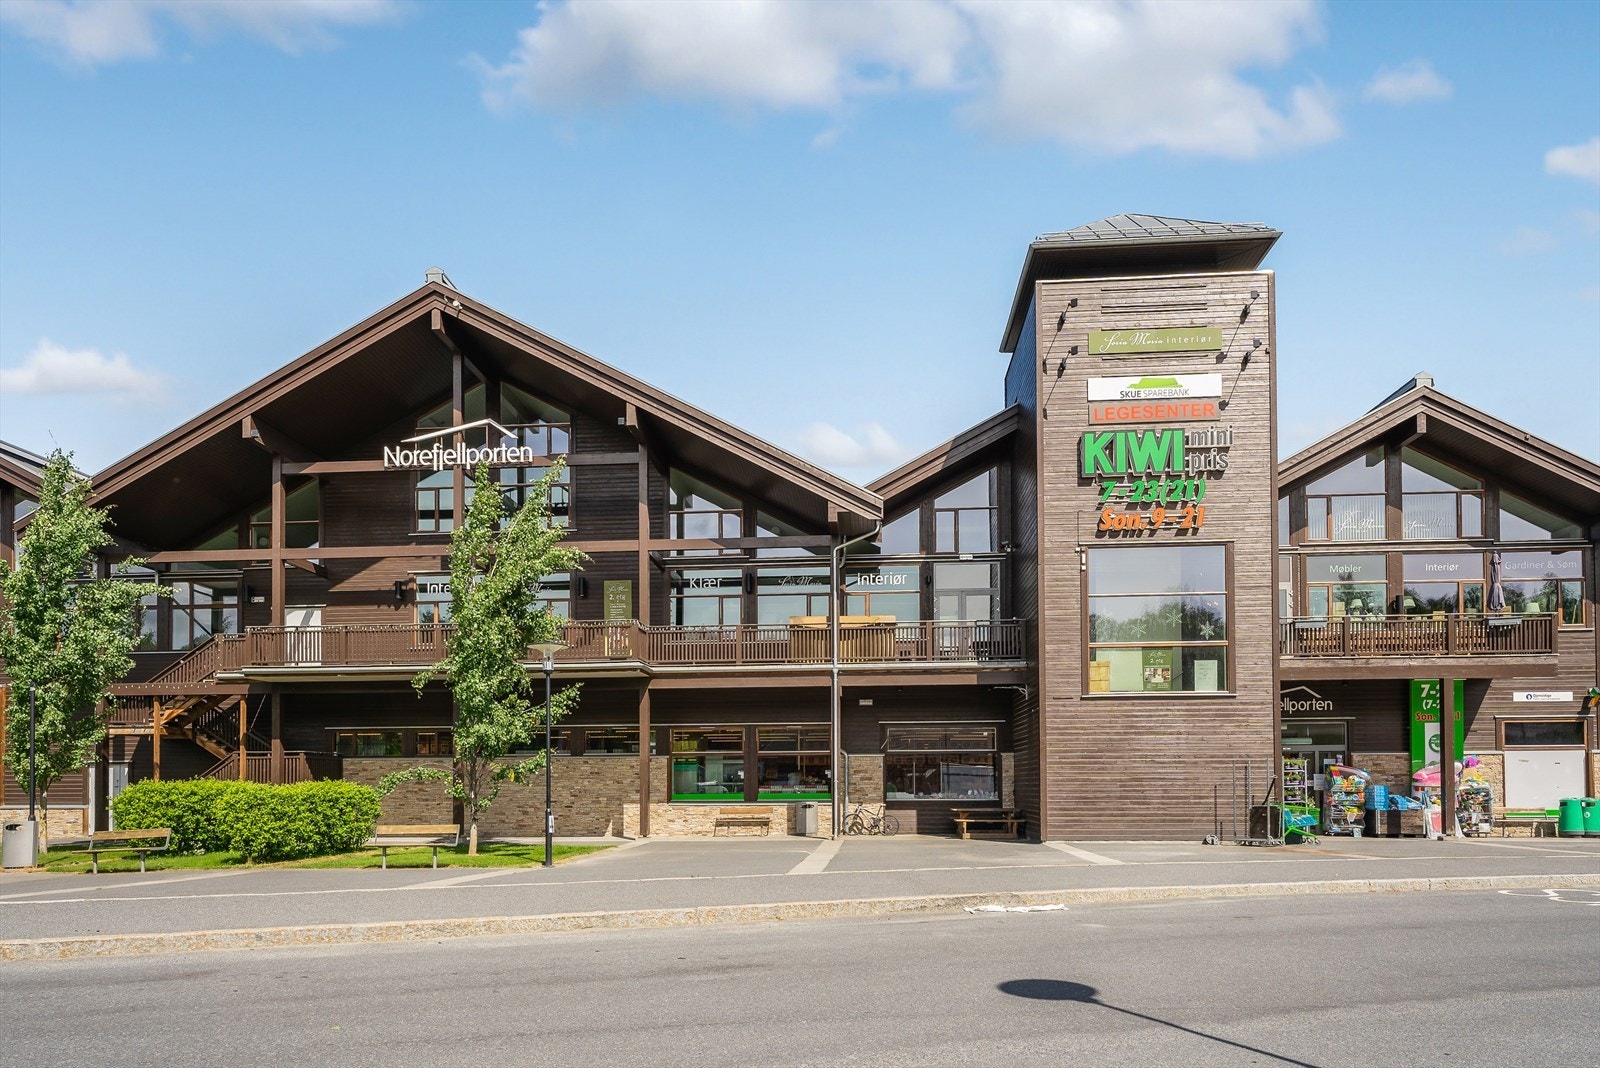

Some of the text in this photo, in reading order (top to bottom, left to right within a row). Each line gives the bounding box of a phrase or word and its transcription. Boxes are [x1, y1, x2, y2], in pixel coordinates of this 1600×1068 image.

[1166, 335, 1212, 344] interiør
[1119, 388, 1190, 399] SKUE SPAREBANK
[1093, 402, 1216, 421] LEGESENTER
[1190, 425, 1233, 446] mini
[384, 442, 533, 470] Norefjellporten
[1083, 428, 1185, 476] KIWI
[1189, 448, 1229, 475] pris
[1329, 565, 1362, 573] Møbler
[1425, 563, 1459, 572] Interiør
[1504, 560, 1577, 570] Gardiner & Søm
[689, 576, 722, 589] Klær
[857, 572, 907, 586] Interiør
[427, 582, 451, 594] Inte
[1280, 697, 1333, 714] ellporten
